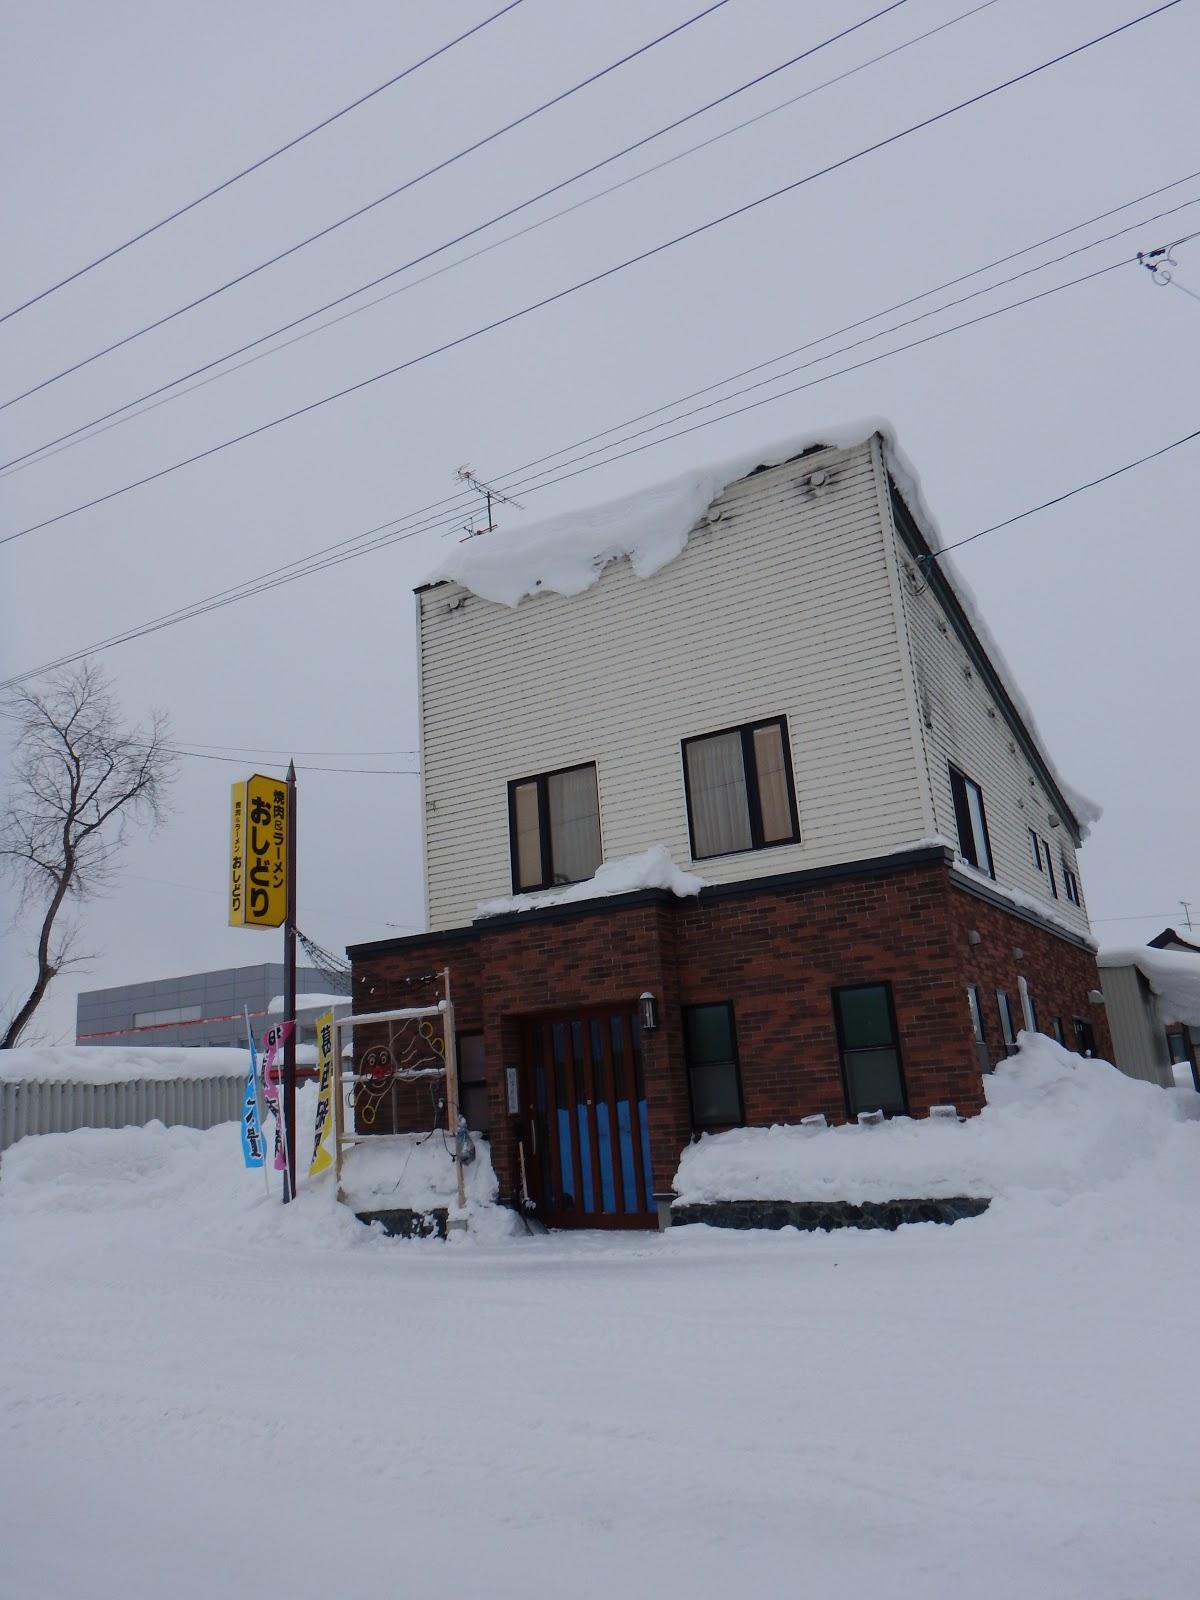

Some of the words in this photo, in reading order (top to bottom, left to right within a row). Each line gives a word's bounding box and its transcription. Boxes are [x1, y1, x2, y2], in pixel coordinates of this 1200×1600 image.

[232, 857, 241, 912] おしどり
[250, 797, 271, 917] おしどり
